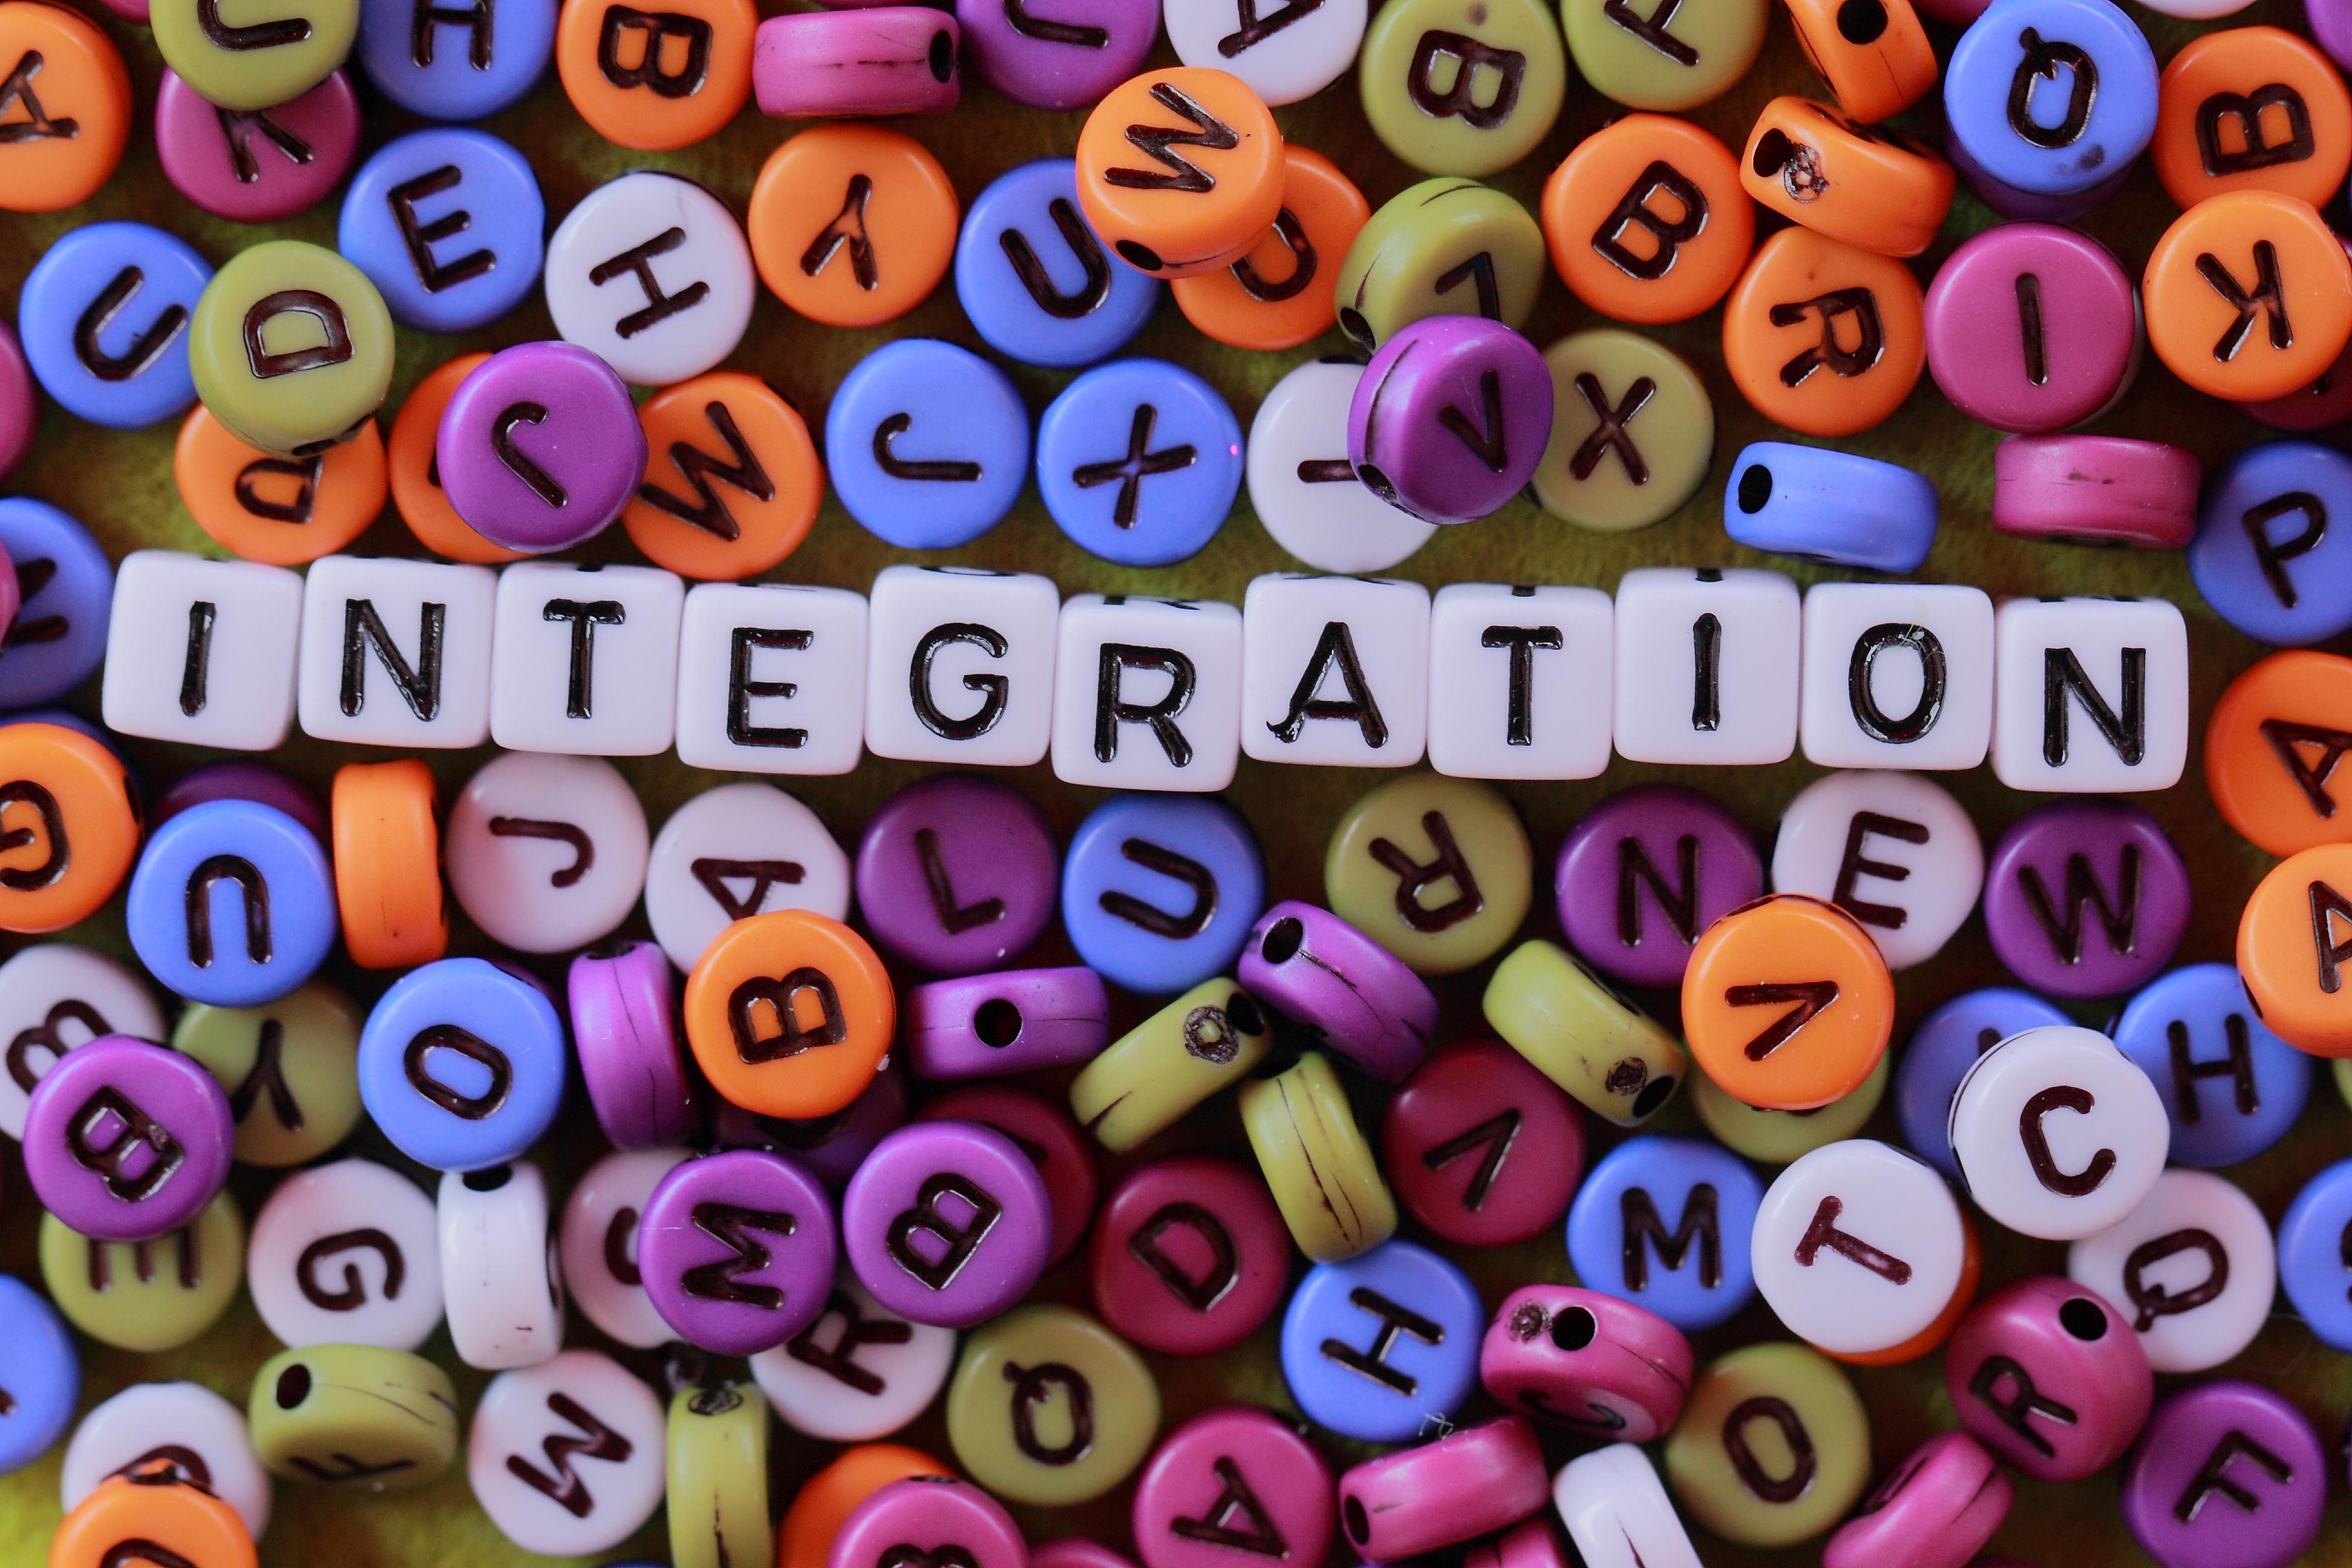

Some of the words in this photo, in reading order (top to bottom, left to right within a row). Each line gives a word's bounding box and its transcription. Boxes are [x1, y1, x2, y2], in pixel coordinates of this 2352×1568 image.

[412, 0, 494, 70] H
[598, 4, 713, 99] B
[1406, 29, 1527, 131] B
[2007, 25, 2100, 150] Q
[1103, 82, 1240, 193] W
[2195, 83, 2314, 178] B
[387, 165, 497, 293] E
[800, 173, 873, 291] Y
[999, 197, 1111, 319] U
[1590, 159, 1710, 281] B
[74, 265, 188, 381] U
[243, 289, 355, 379] D
[589, 226, 709, 340] H
[1769, 286, 1886, 388] R
[2015, 272, 2048, 387] I
[2195, 239, 2293, 362] K
[492, 402, 567, 508] J
[639, 400, 776, 541] W
[873, 412, 984, 482] J
[1073, 403, 1197, 529] X
[1439, 369, 1508, 474] V
[1570, 371, 1656, 485] X
[2241, 491, 2327, 609] P
[180, 597, 2146, 768] INTEGRATION
[2259, 718, 2352, 818] A
[0, 780, 70, 891] G
[489, 815, 595, 888] J
[690, 857, 806, 921] A
[914, 828, 1005, 935] L
[1099, 838, 1218, 941] U
[1368, 809, 1485, 933] R
[1617, 833, 1702, 947] N
[1832, 810, 1930, 930] E
[185, 854, 273, 969] U
[2016, 843, 2142, 965] W
[728, 966, 847, 1065] B
[1724, 980, 1840, 1062] V
[2167, 1013, 2260, 1124] H
[232, 1018, 302, 1132] Y
[403, 1024, 513, 1121] O
[65, 1086, 185, 1202] B
[1422, 1108, 1522, 1213] V
[2019, 1085, 2116, 1198] C
[296, 1227, 407, 1312] G
[681, 1202, 797, 1310] M
[886, 1172, 1003, 1291] B
[1128, 1200, 1242, 1312] D
[1621, 1182, 1722, 1292] M
[1794, 1194, 1912, 1286] T
[2123, 1228, 2229, 1333] Q
[1321, 1286, 1445, 1396] H
[506, 1393, 633, 1518] W
[1003, 1359, 1095, 1466] Q
[1722, 1396, 1816, 1504] O
[1969, 1355, 2078, 1458] R
[1169, 1455, 1290, 1560] A
[2174, 1428, 2294, 1524] F
